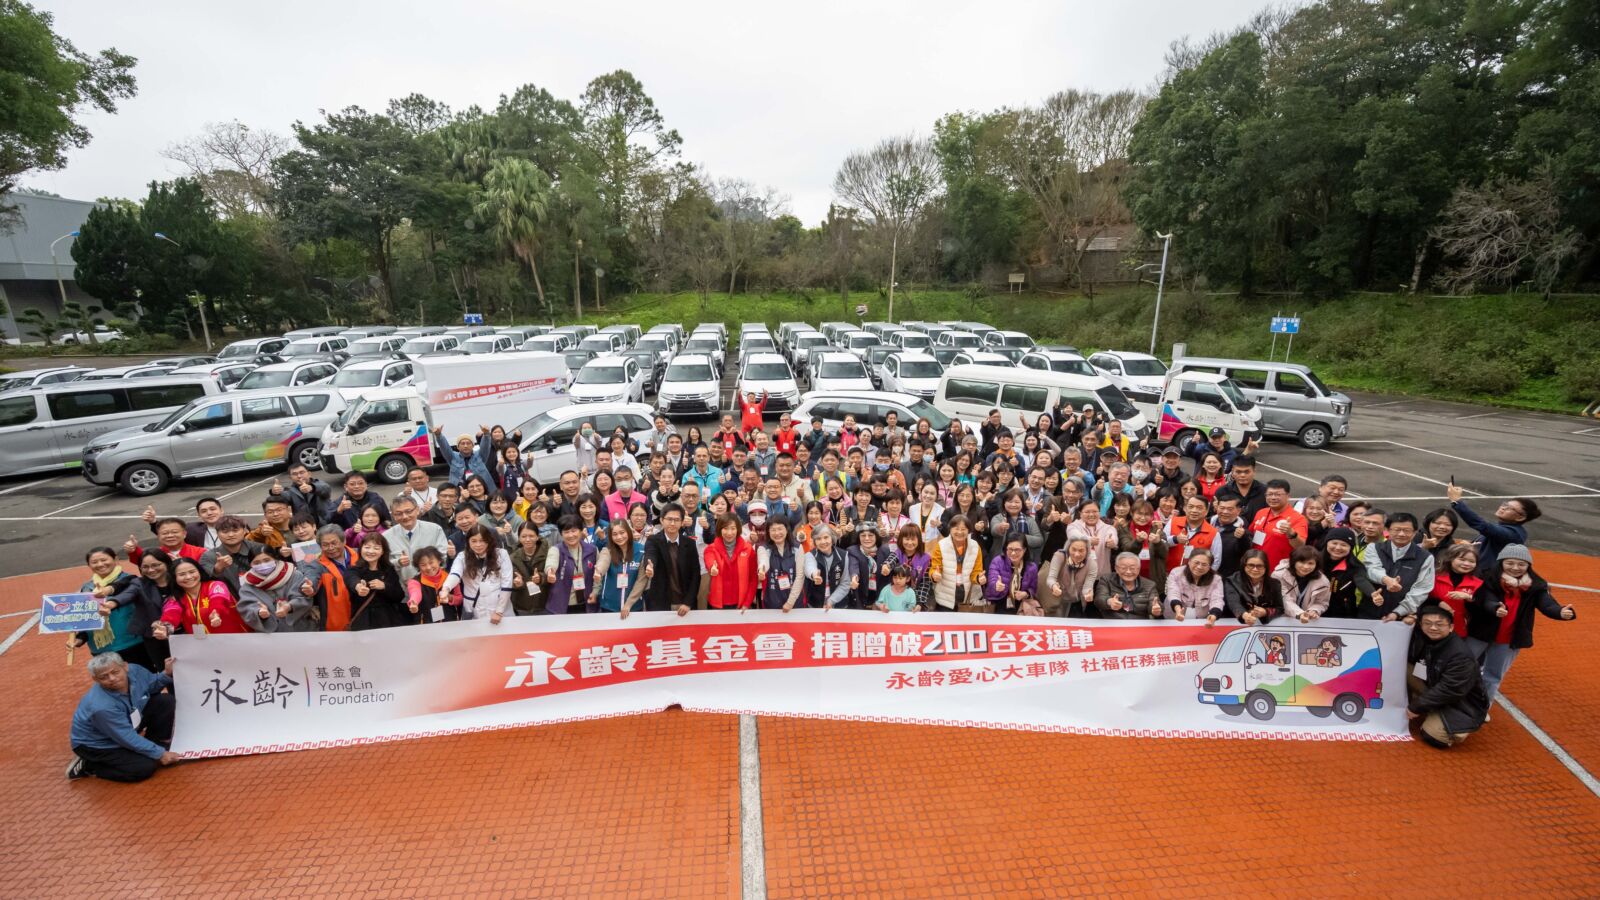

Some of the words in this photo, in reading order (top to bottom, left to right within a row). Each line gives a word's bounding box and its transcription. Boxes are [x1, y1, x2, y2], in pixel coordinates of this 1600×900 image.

[504, 633, 795, 688] 永齡基金會
[810, 629, 1095, 660] 捐贈破200台交通車
[886, 660, 1070, 689] 永齡愛心大車隊
[1080, 650, 1200, 674] 社福任務無極限
[315, 665, 362, 680] 基金會
[318, 680, 373, 692] YongLin
[201, 667, 300, 713] 永齡
[318, 691, 394, 706] Foundation
